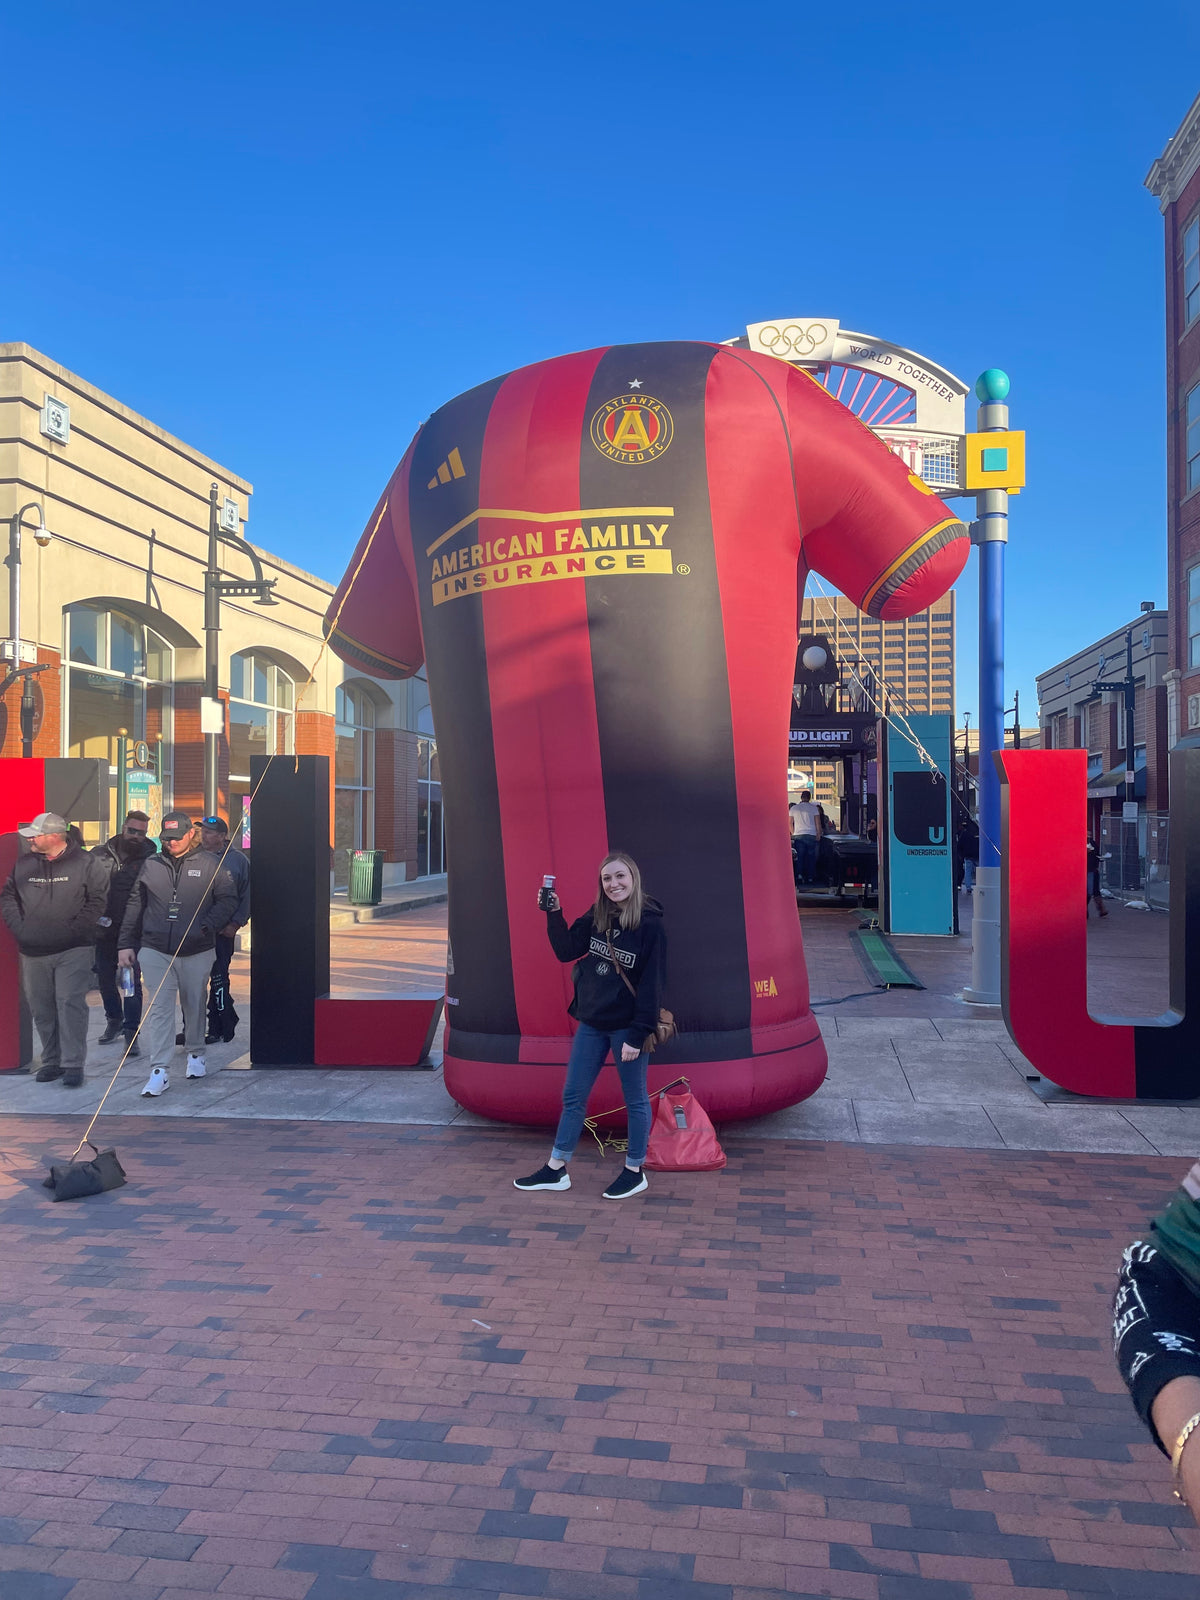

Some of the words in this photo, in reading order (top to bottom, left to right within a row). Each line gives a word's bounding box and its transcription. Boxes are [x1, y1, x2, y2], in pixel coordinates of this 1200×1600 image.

[849, 345, 893, 366] WORLD
[897, 361, 954, 403] TOGETHER
[605, 396, 662, 413] ATLANTA
[600, 441, 645, 462] UNITED
[648, 442, 664, 456] FC
[431, 531, 544, 581] AMERICAN
[555, 523, 669, 552] FAMILY
[443, 553, 646, 597] INSURANCE
[789, 730, 808, 741] UD
[810, 731, 850, 741] LIGHT
[928, 826, 945, 844] U
[906, 848, 948, 857] UNDERGROUND
[590, 940, 632, 964] ONQURED
